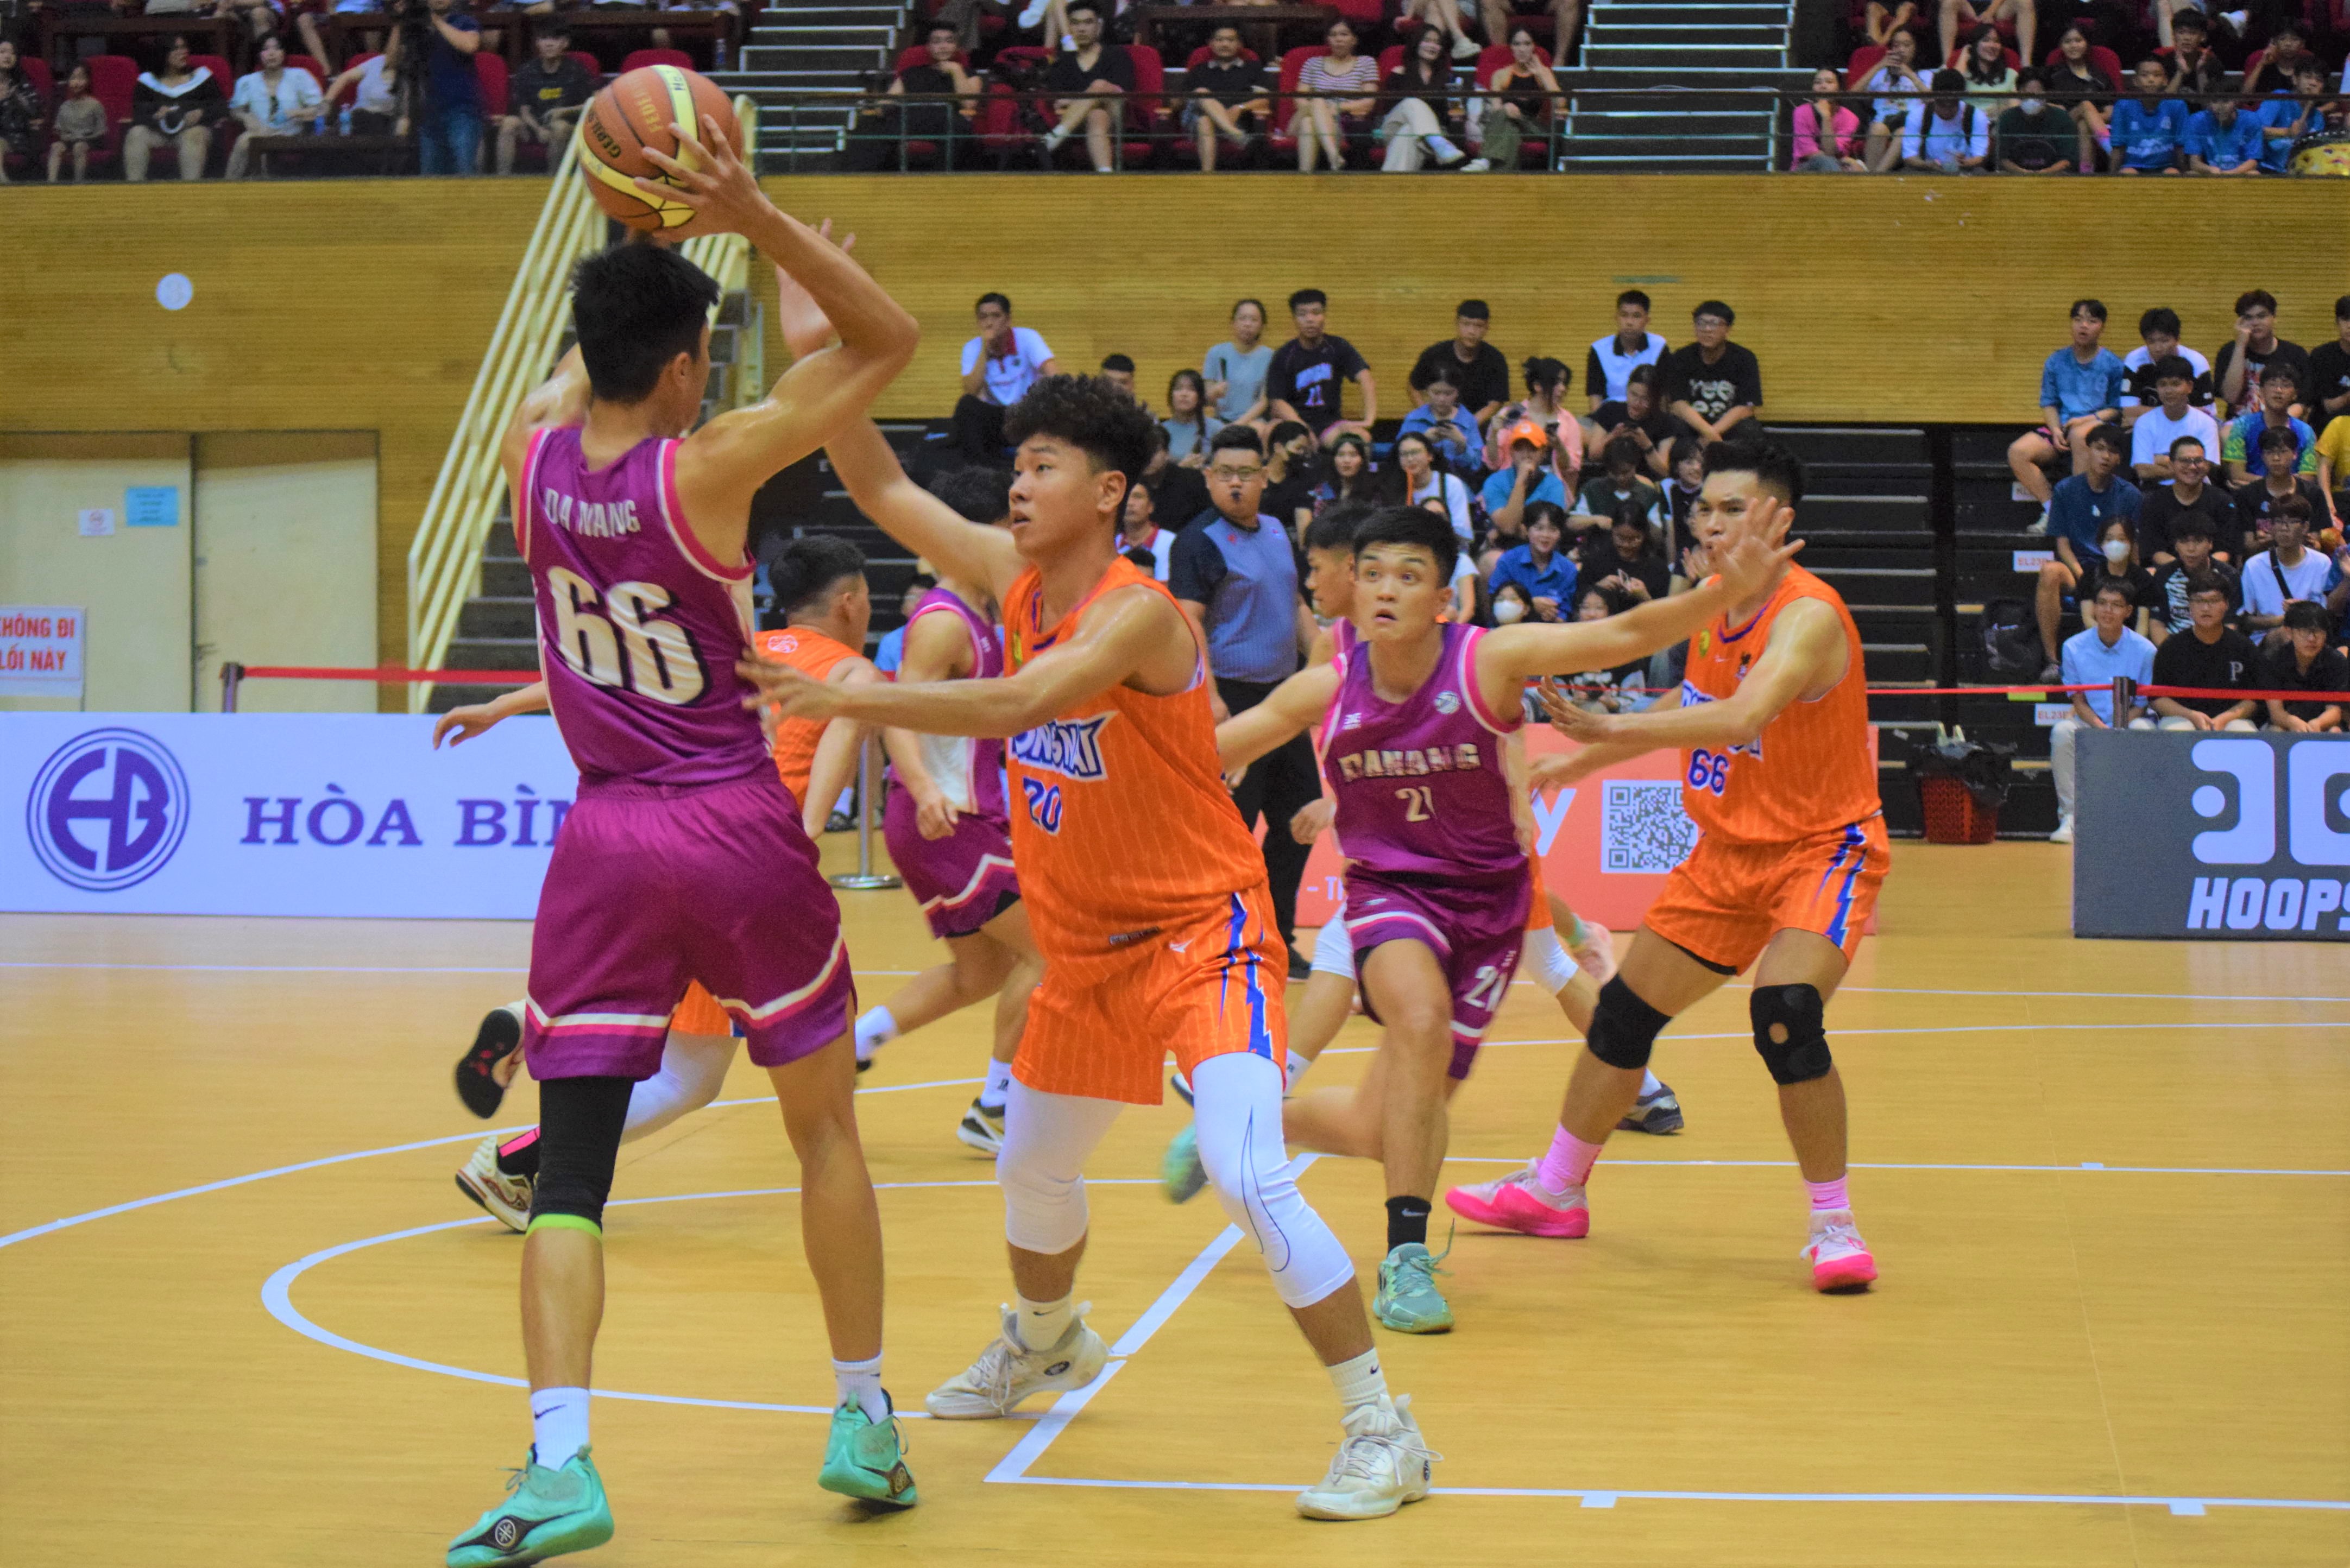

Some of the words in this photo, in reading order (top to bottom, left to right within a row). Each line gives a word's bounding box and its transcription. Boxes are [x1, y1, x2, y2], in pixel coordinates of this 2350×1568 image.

[544, 488, 573, 532] DA
[577, 499, 641, 538] NANG
[0, 614, 51, 638] HÔNG
[547, 566, 708, 705] 66
[2229, 661, 2244, 681] P
[1689, 748, 1729, 795] 66
[240, 783, 423, 846] HÒA
[1023, 776, 1062, 835] 20
[1394, 786, 1437, 823] 21
[1462, 965, 1509, 1011] 21
